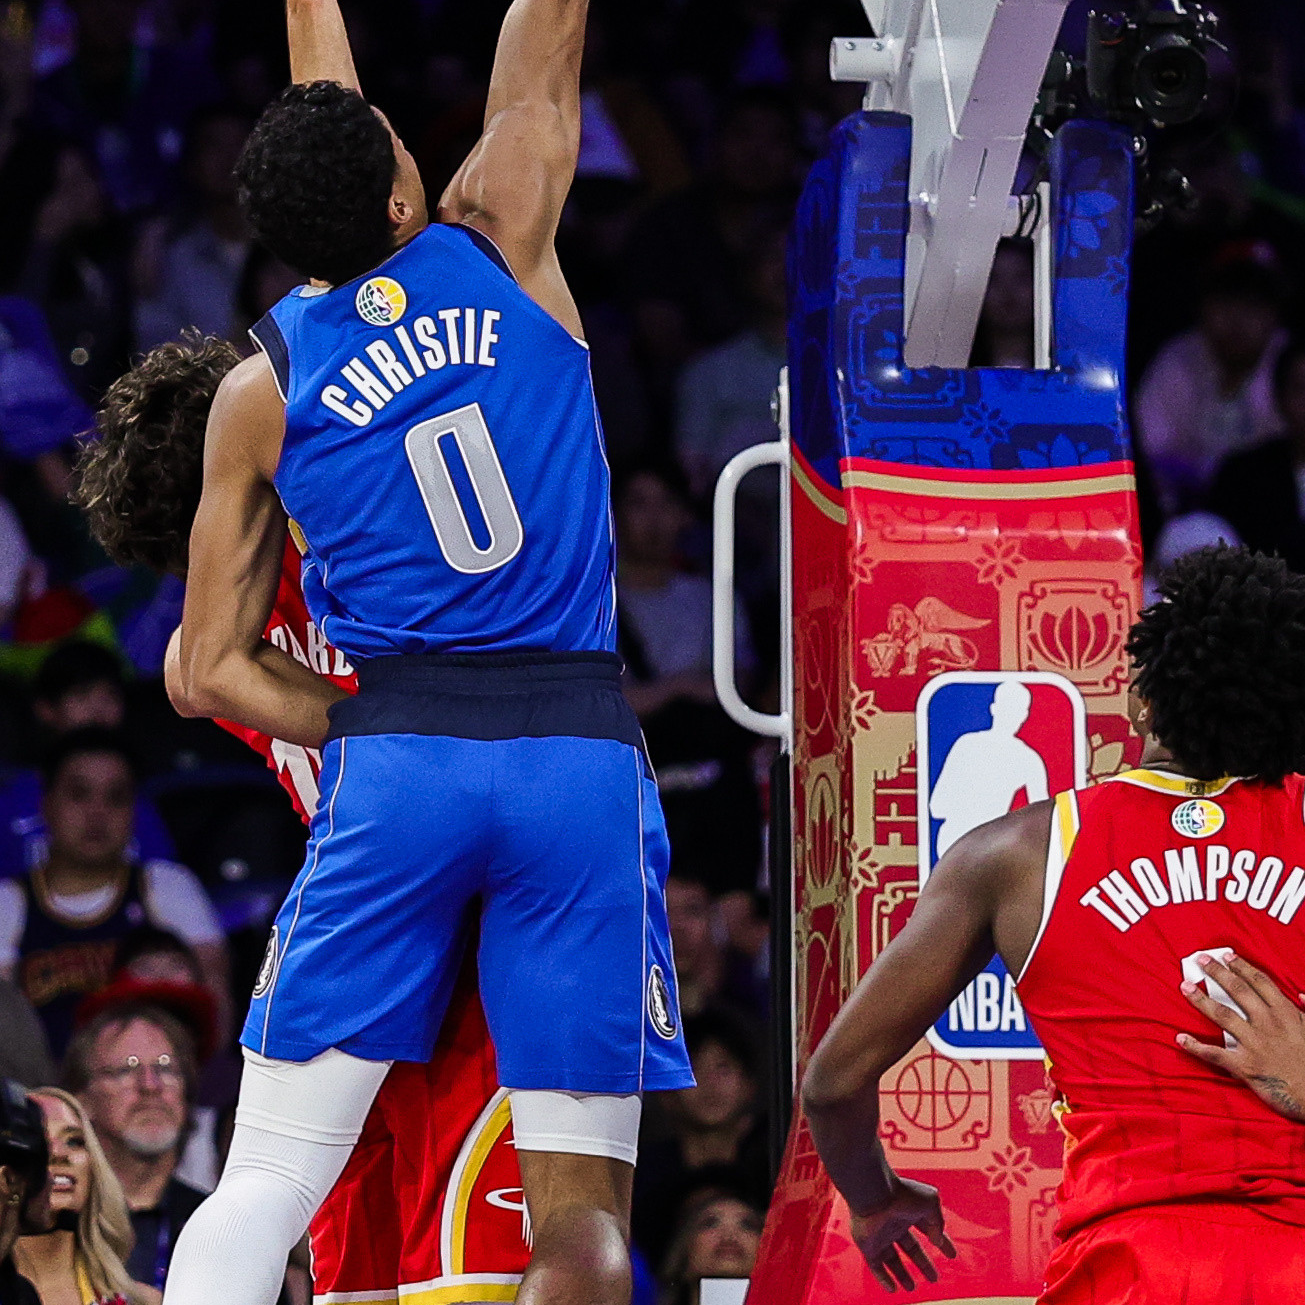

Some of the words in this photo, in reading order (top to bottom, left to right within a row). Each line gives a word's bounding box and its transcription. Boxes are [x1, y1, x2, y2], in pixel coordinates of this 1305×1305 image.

[320, 307, 501, 428] CHRISTIE
[404, 402, 524, 574] 0
[948, 972, 1027, 1032] NBA
